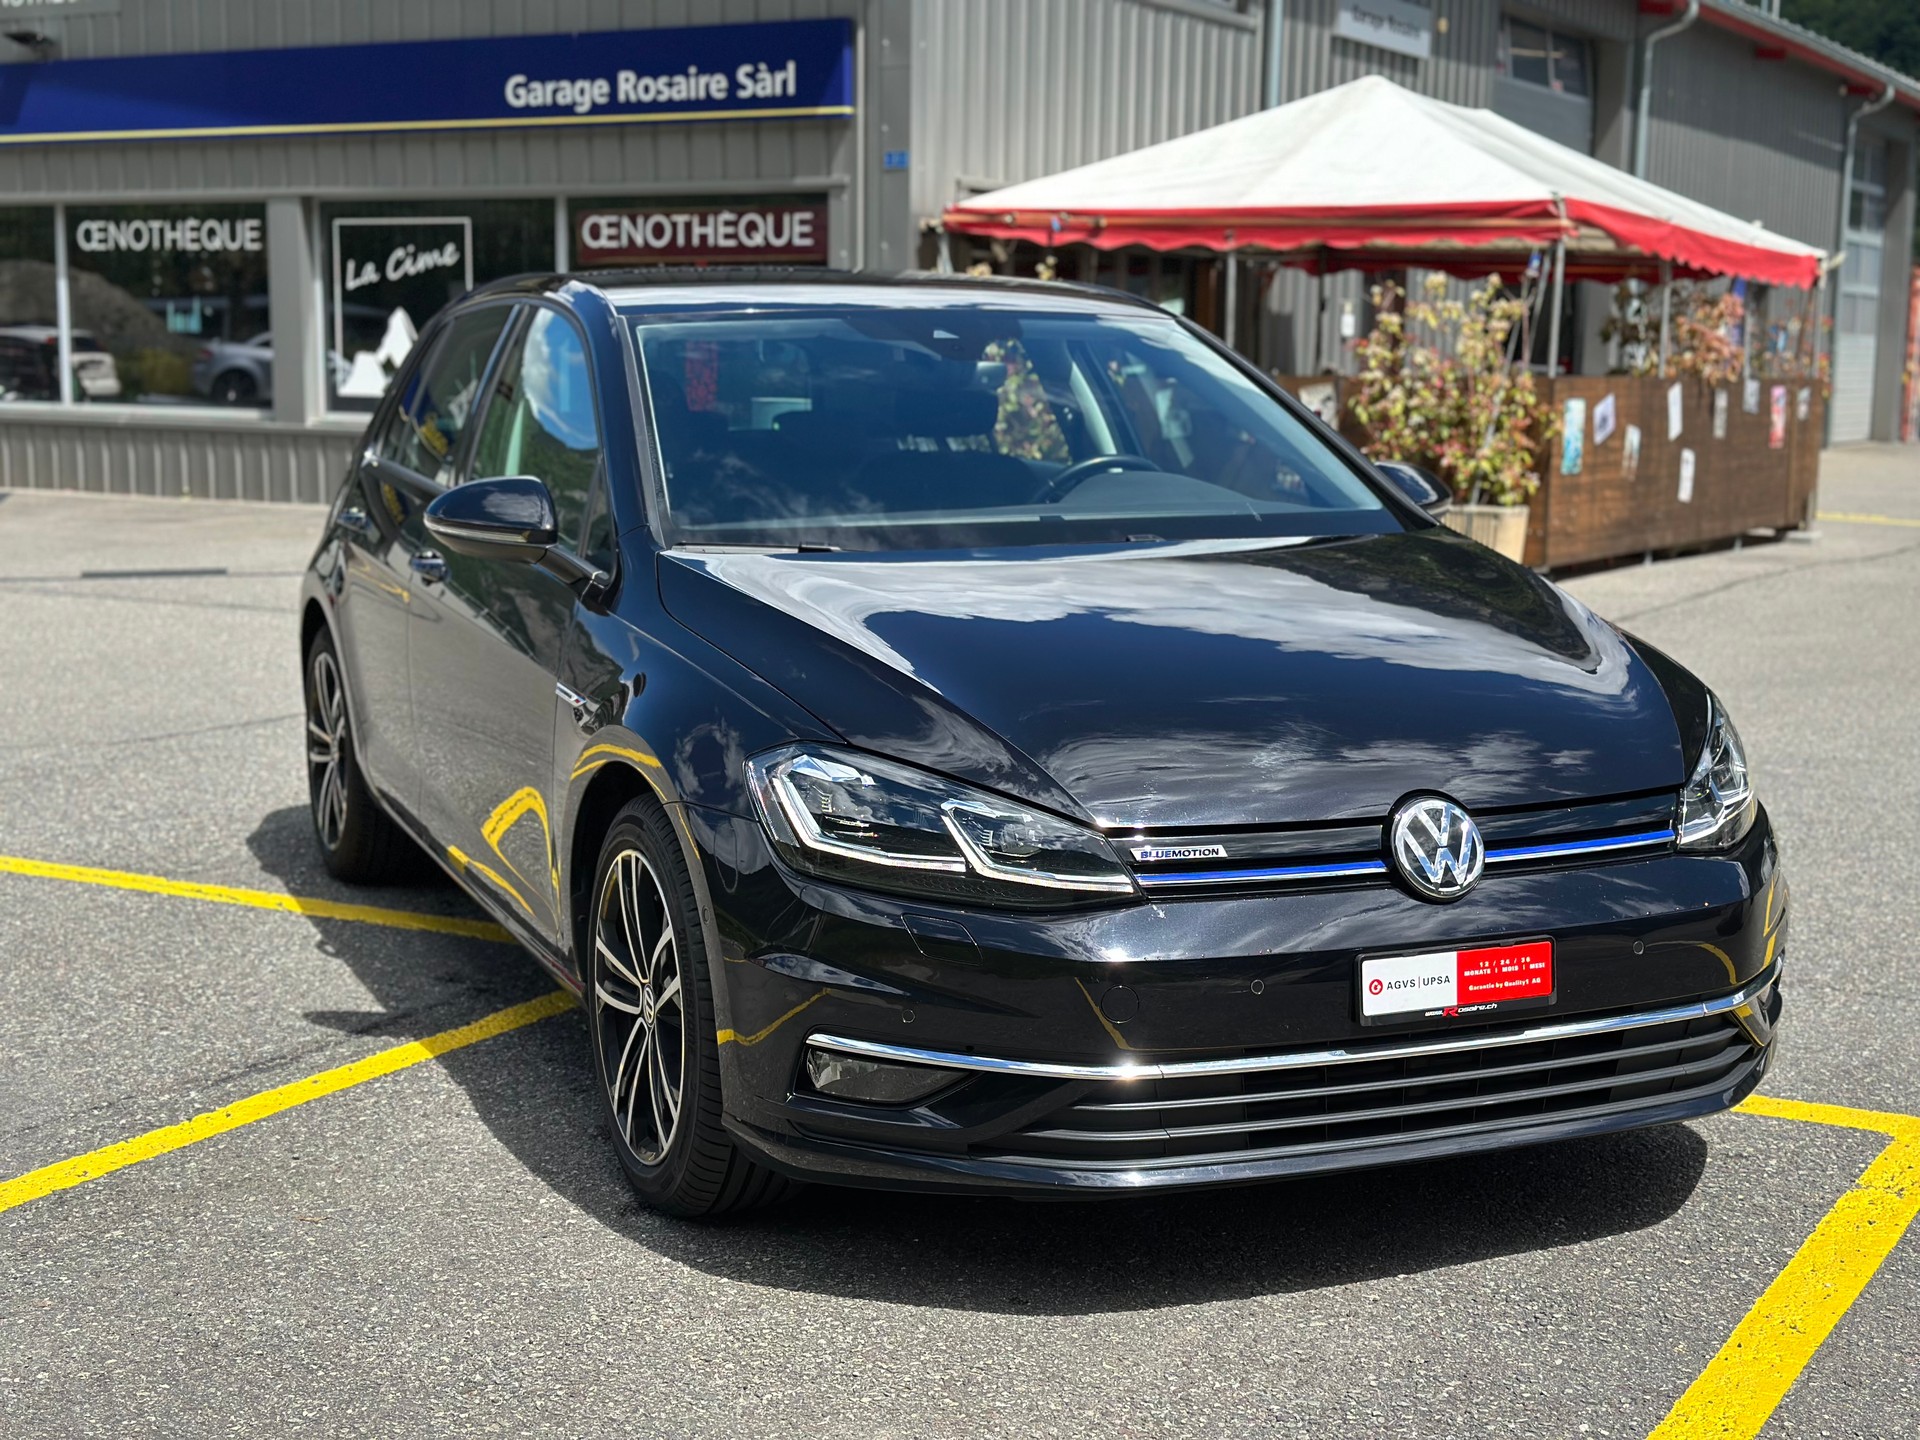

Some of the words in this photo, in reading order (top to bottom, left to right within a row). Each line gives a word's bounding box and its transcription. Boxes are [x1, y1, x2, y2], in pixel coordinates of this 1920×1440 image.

[505, 74, 611, 113] Garage
[617, 66, 728, 104] Rosaire
[736, 60, 796, 98] Sàrl
[345, 259, 380, 291] La
[385, 241, 460, 282] Cime
[1140, 848, 1219, 859] BLUEMOTION
[1394, 799, 1483, 897] VW
[1464, 968, 1491, 976] MONATE
[1502, 965, 1519, 973] MOIS
[1479, 960, 1489, 968] 12
[1386, 978, 1416, 990] AGVS
[1422, 975, 1451, 987] UPSA
[1468, 982, 1494, 991] Garantie
